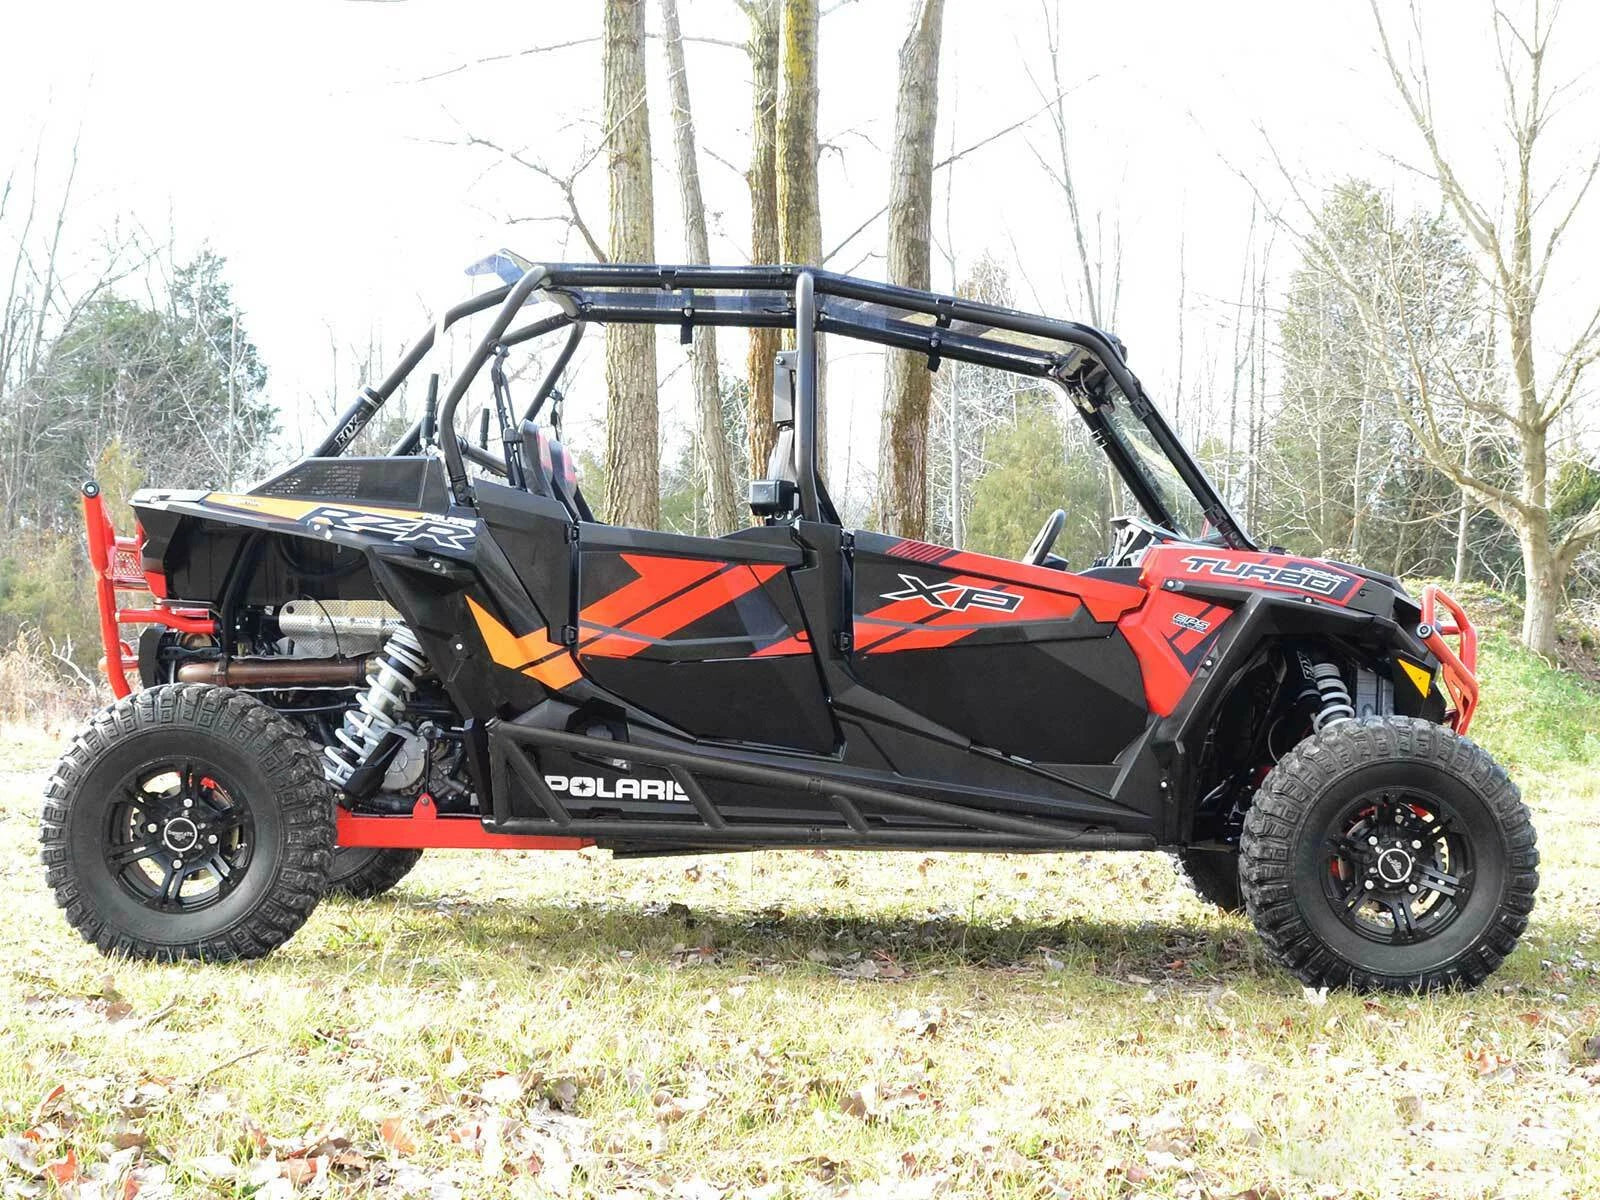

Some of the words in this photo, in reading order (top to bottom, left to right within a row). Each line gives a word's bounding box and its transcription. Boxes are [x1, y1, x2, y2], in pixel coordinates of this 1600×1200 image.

[335, 414, 362, 449] FOX
[297, 506, 476, 550] RZR
[879, 573, 1024, 614] XP
[1180, 556, 1342, 595] TURBO
[1172, 612, 1211, 630] EPS
